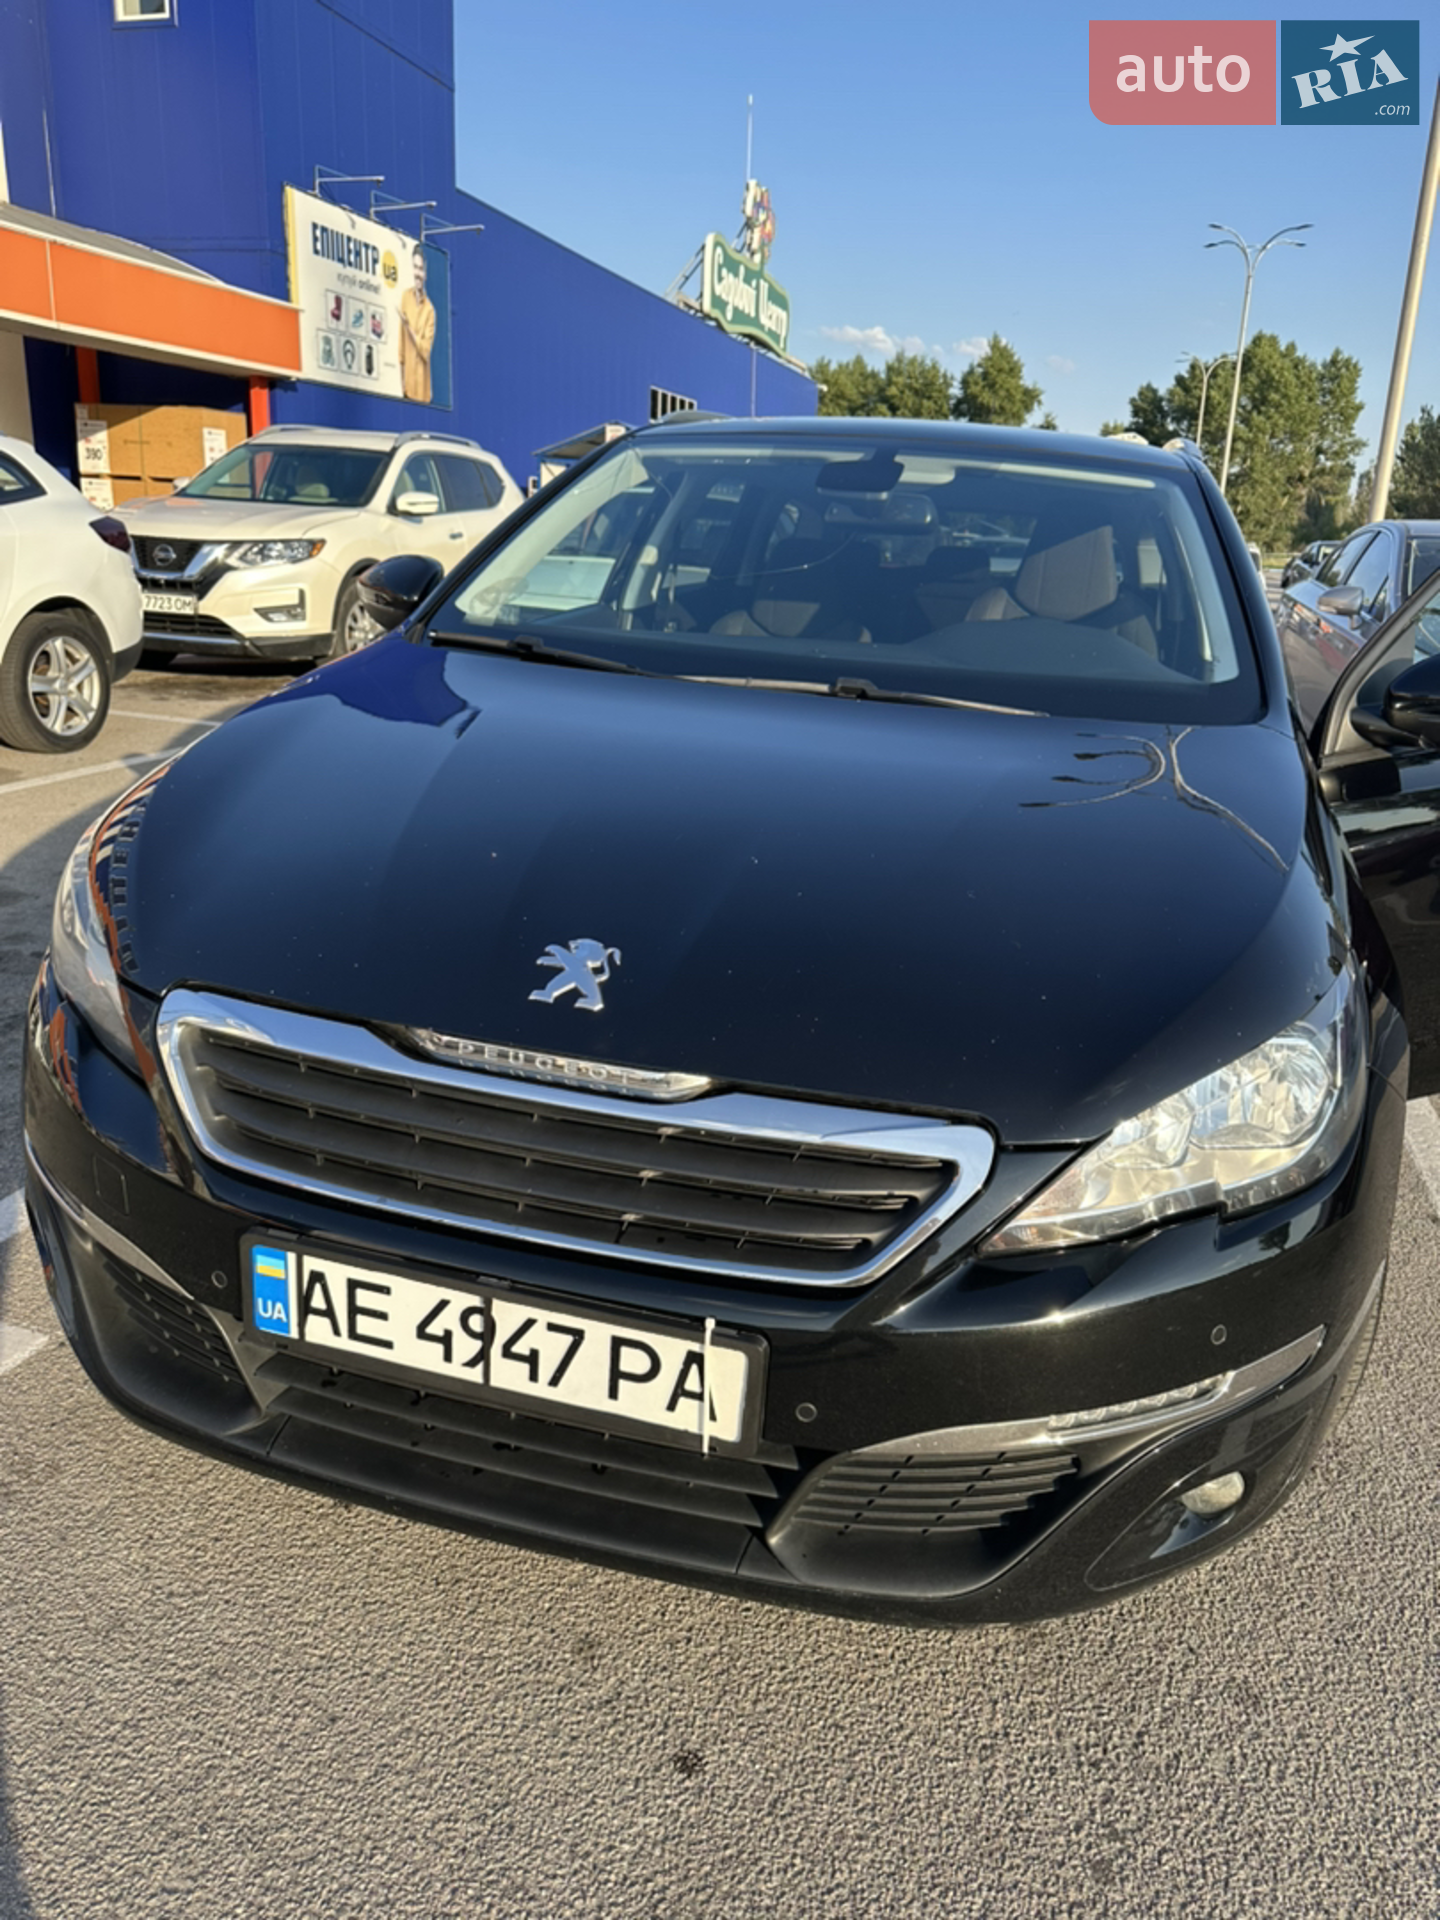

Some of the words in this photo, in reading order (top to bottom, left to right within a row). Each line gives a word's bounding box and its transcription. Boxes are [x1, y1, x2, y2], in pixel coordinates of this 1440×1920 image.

[312, 221, 379, 275] ЕПІЦЕНТР
[383, 262, 397, 282] ua
[145, 595, 173, 610] 7723
[457, 1041, 633, 1084] PEUGEOT
[257, 1297, 289, 1323] UA
[303, 1269, 395, 1351] AE
[415, 1298, 586, 1388] 4947
[608, 1335, 718, 1423] PA
